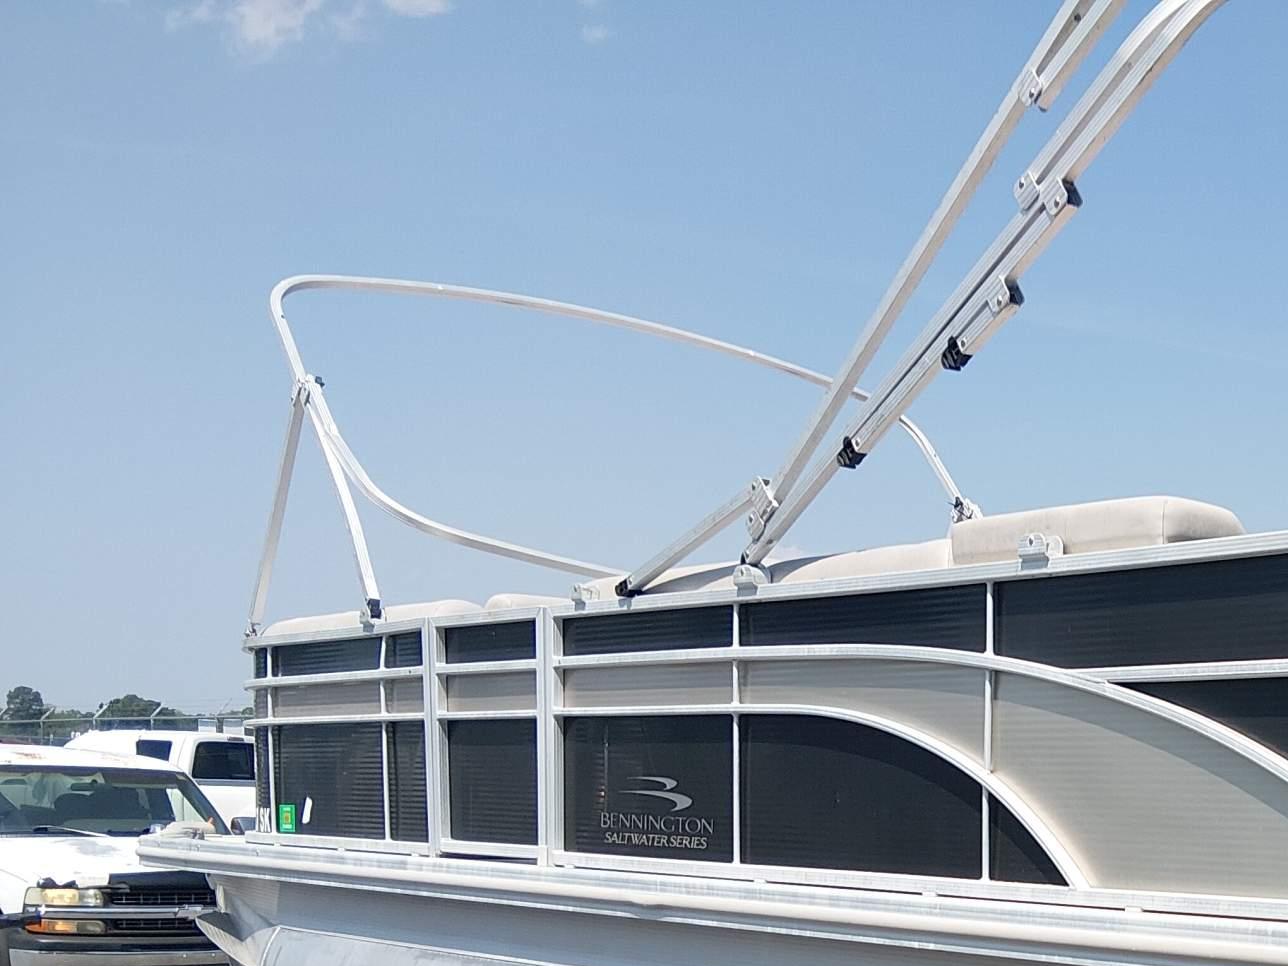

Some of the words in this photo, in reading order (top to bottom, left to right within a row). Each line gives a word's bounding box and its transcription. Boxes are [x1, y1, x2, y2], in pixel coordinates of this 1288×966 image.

[600, 811, 713, 832] BENNINGTON
[605, 832, 668, 846] SALTWATER
[668, 836, 707, 849] SERIES
